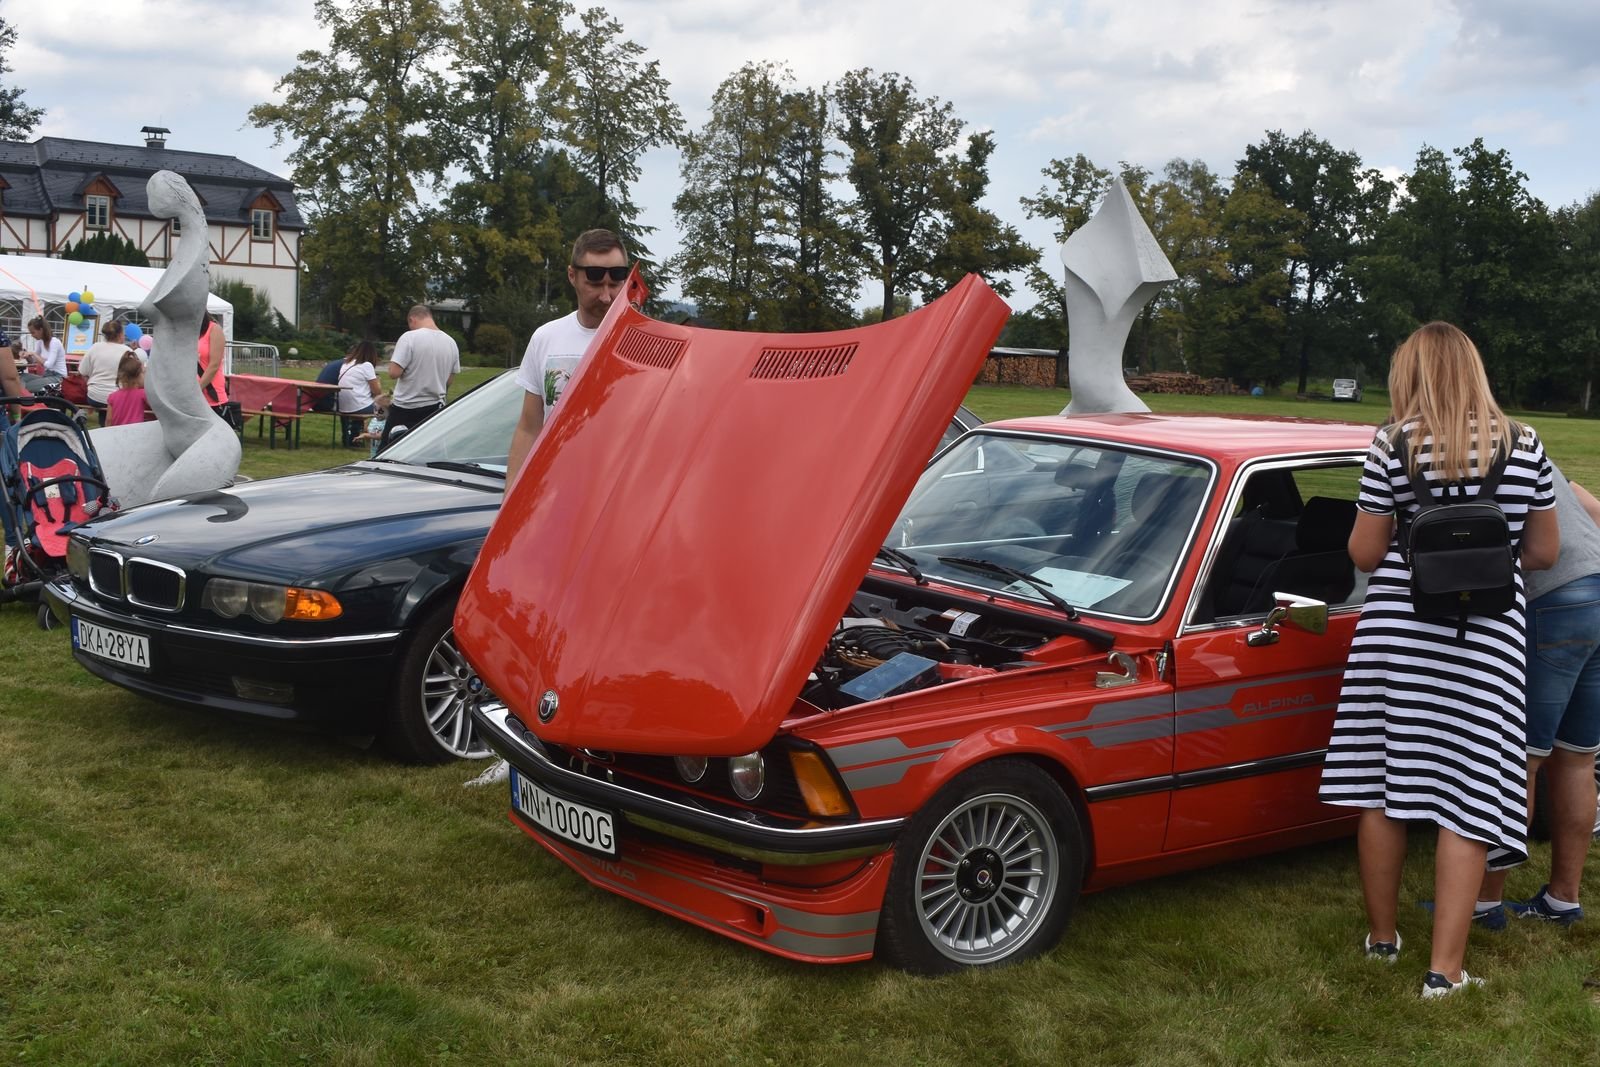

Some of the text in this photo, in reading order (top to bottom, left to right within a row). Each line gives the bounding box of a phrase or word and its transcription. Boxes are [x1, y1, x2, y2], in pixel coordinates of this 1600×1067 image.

[81, 622, 146, 665] DKA 28YA
[1241, 693, 1315, 714] ALPINA
[519, 776, 612, 849] WN 1000G
